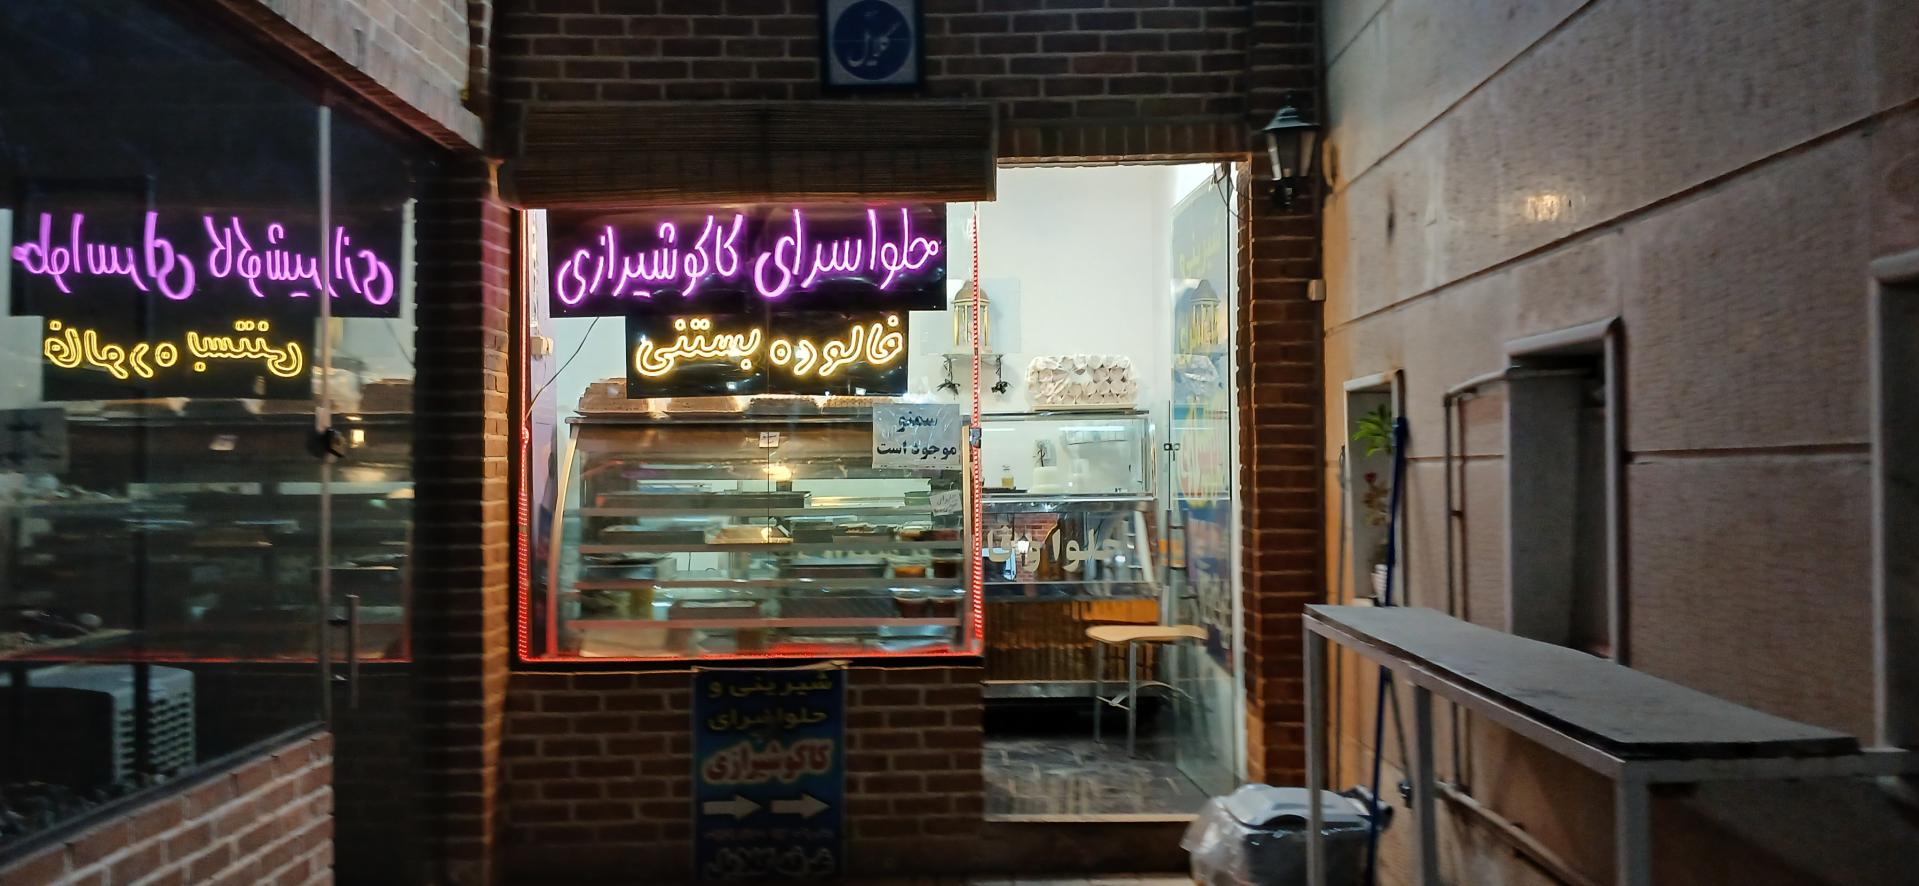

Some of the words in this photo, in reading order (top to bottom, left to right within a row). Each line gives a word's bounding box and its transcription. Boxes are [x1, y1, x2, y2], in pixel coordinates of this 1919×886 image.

[635, 318, 761, 377] بستنی
[769, 315, 903, 376] فالوده
[896, 411, 938, 432] سمنو
[877, 440, 907, 455] است
[911, 444, 957, 460] موجود
[706, 681, 724, 699] و
[728, 673, 833, 697] شیرینی
